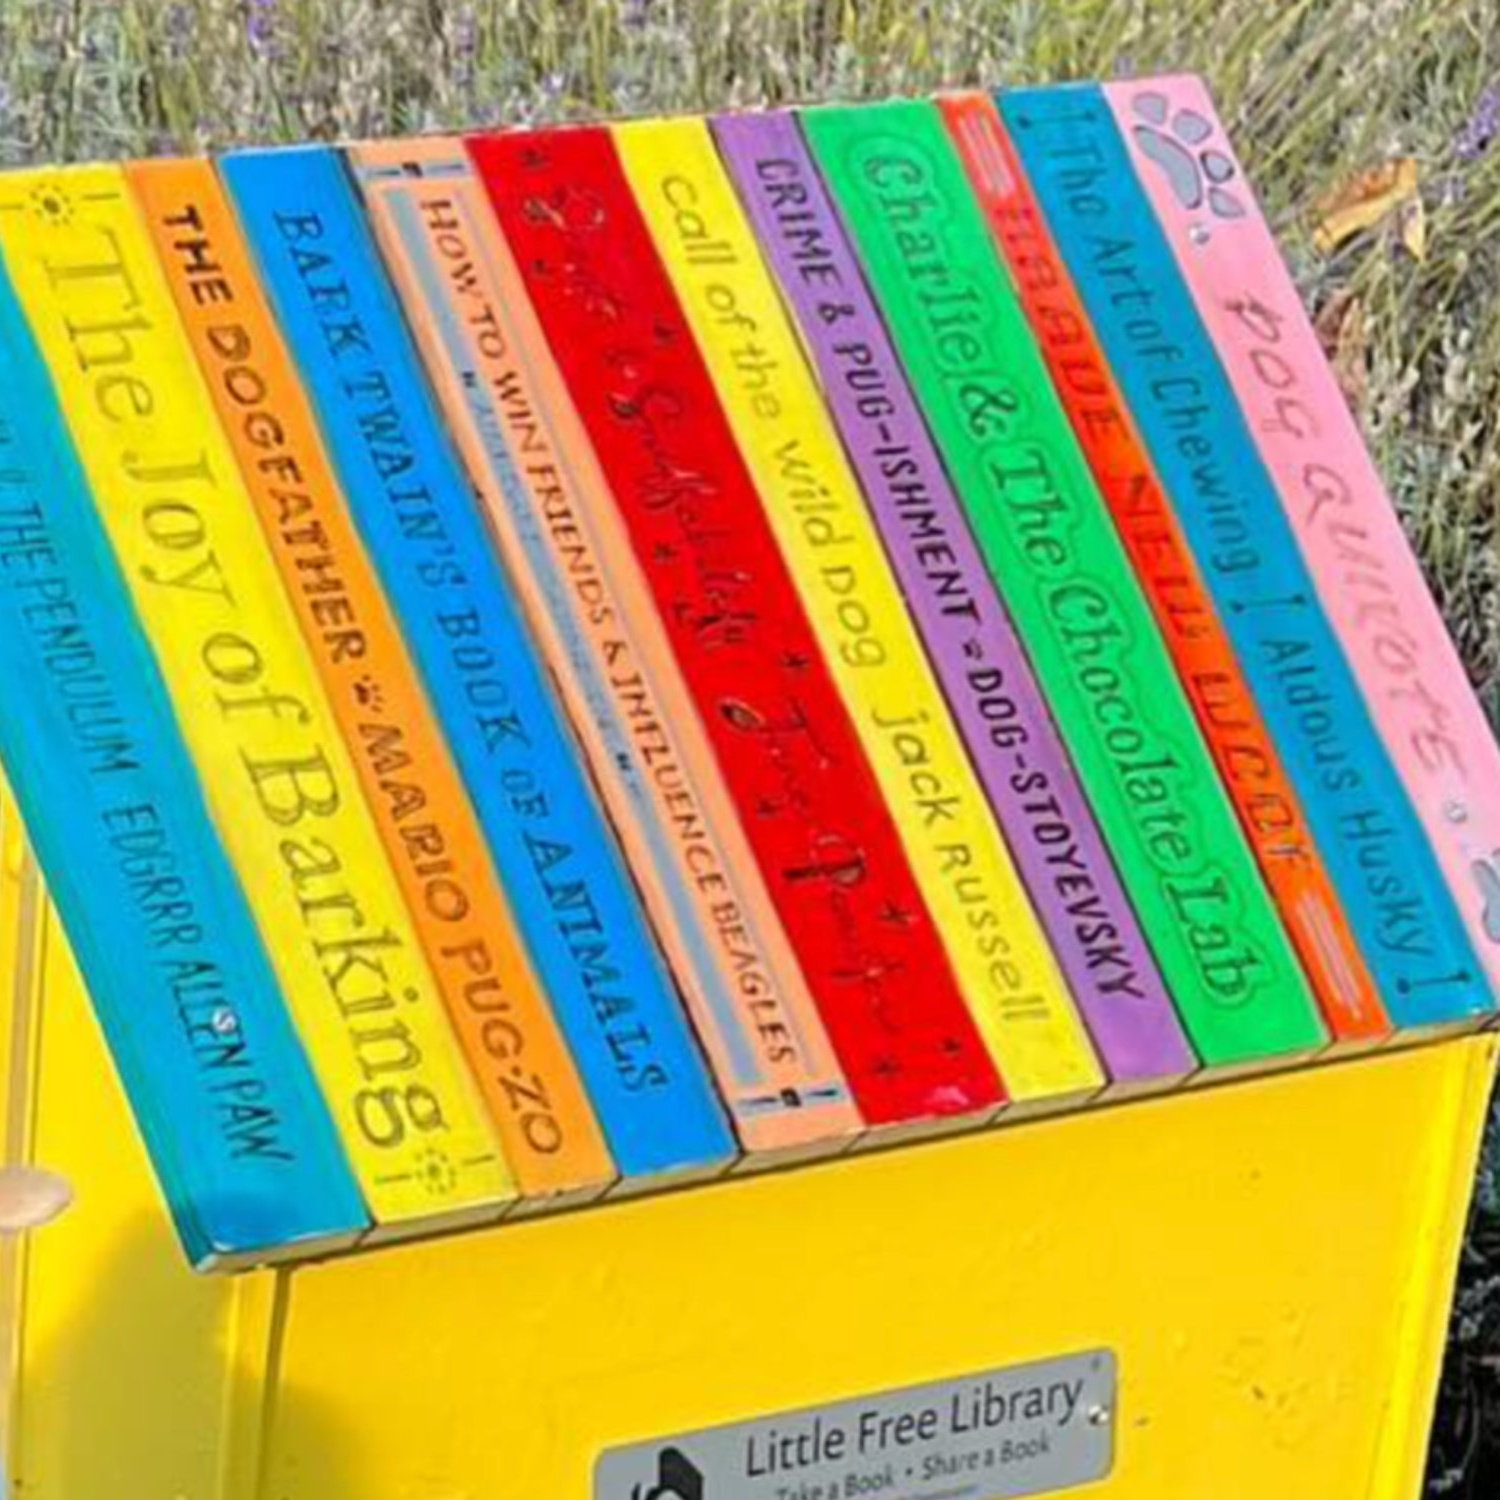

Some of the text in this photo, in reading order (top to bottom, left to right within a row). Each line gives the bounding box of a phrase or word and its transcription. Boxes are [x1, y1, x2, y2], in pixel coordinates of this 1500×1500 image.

[416, 196, 489, 300] HOW
[698, 281, 758, 336] of
[460, 304, 511, 360] TO
[725, 341, 798, 421] the
[1208, 294, 1336, 441] DOG
[487, 370, 551, 454] WIN
[159, 204, 235, 305] THE
[202, 322, 375, 664] DOGFATHER
[355, 718, 475, 926] MARIO
[523, 461, 621, 626] FRIENDS
[751, 156, 1146, 1007] CRIME & PUG-ISHMENT DOG-STOYEVSKY
[857, 153, 1274, 1001] Charlie & The Chocolate Lab
[1043, 138, 1442, 965] The Art of Chewing Aldous Husky
[1104, 473, 1213, 644] NEW
[13, 575, 142, 778] PENDULUM
[29, 224, 474, 1155] The Joy of Barking
[271, 208, 377, 361] BARK
[336, 371, 468, 590] TWAIN'S
[432, 607, 531, 752] BOOK
[520, 825, 672, 1096] ANIMALS
[598, 638, 636, 667] &
[610, 671, 730, 894] INFLUENCE
[99, 802, 207, 950] EDGRRR
[930, 837, 1052, 1027] Russell
[157, 951, 258, 1080] ALLEN
[703, 899, 801, 1066] BEAGLES
[205, 1074, 295, 1173] PAW
[746, 1374, 1084, 1477] Little Free Library
[844, 1468, 895, 1499] Book
[921, 1450, 980, 1481] Share
[1001, 1433, 1051, 1464] Book
